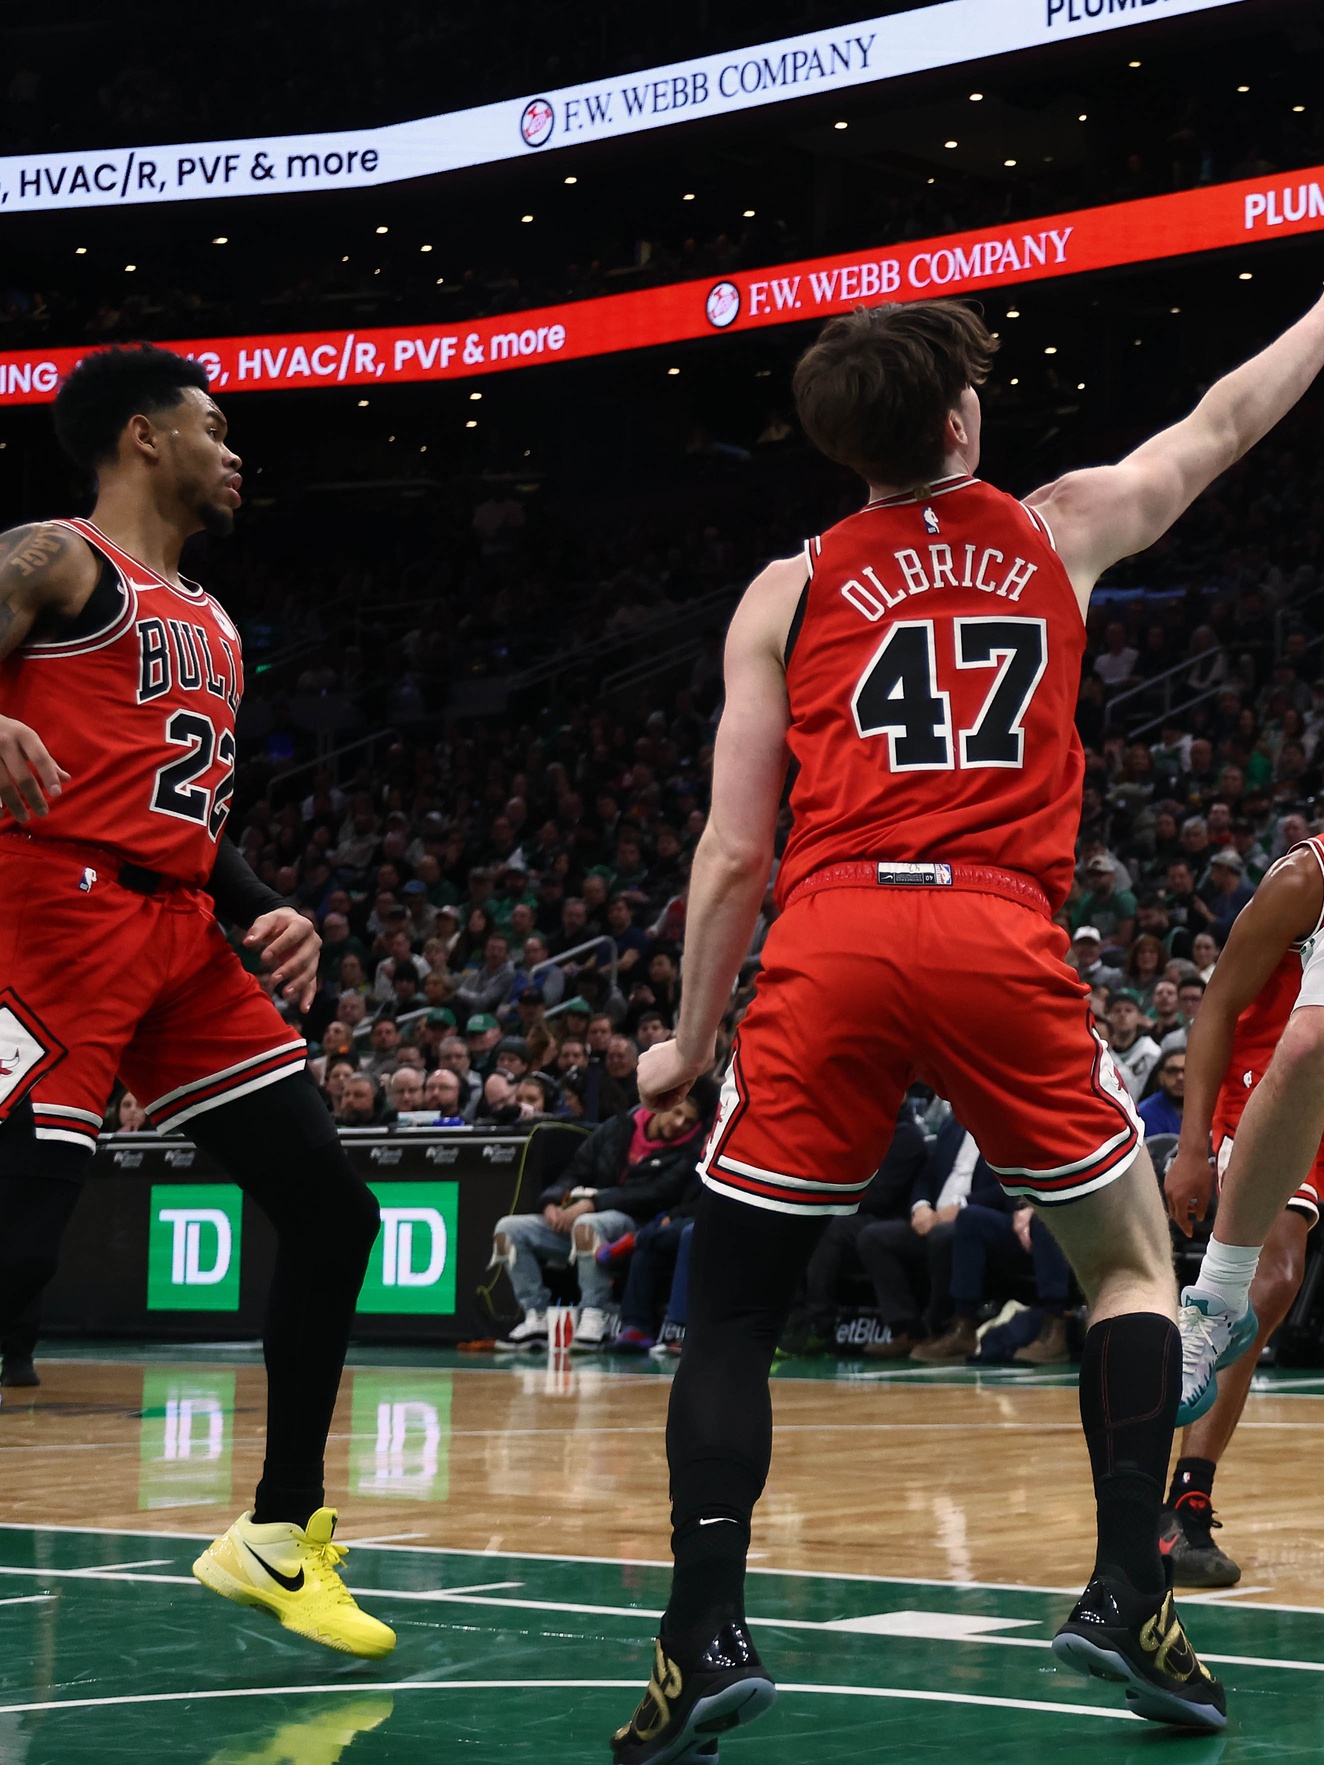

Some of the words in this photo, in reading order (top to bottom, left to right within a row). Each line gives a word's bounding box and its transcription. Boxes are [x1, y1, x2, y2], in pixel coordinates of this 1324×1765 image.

[562, 92, 613, 132] F.W.
[622, 72, 709, 117] WEBB
[718, 33, 877, 97] COMPANY
[19, 152, 166, 197] HVAC/R,
[177, 154, 240, 187] PVF
[251, 152, 275, 181] &
[287, 148, 379, 178] more
[749, 276, 802, 316] F.W.
[809, 259, 901, 303] WEBB
[908, 227, 1074, 288] COMPANY
[238, 334, 385, 381] HVAC/R,
[394, 337, 458, 371] PVF
[462, 334, 485, 365] &
[490, 324, 566, 361] more
[841, 543, 1038, 622] OLBRICH
[135, 617, 244, 716] BULL
[851, 616, 1048, 772] 47
[149, 708, 236, 843] 22
[159, 1208, 232, 1285] TD
[380, 1207, 447, 1286] TD
